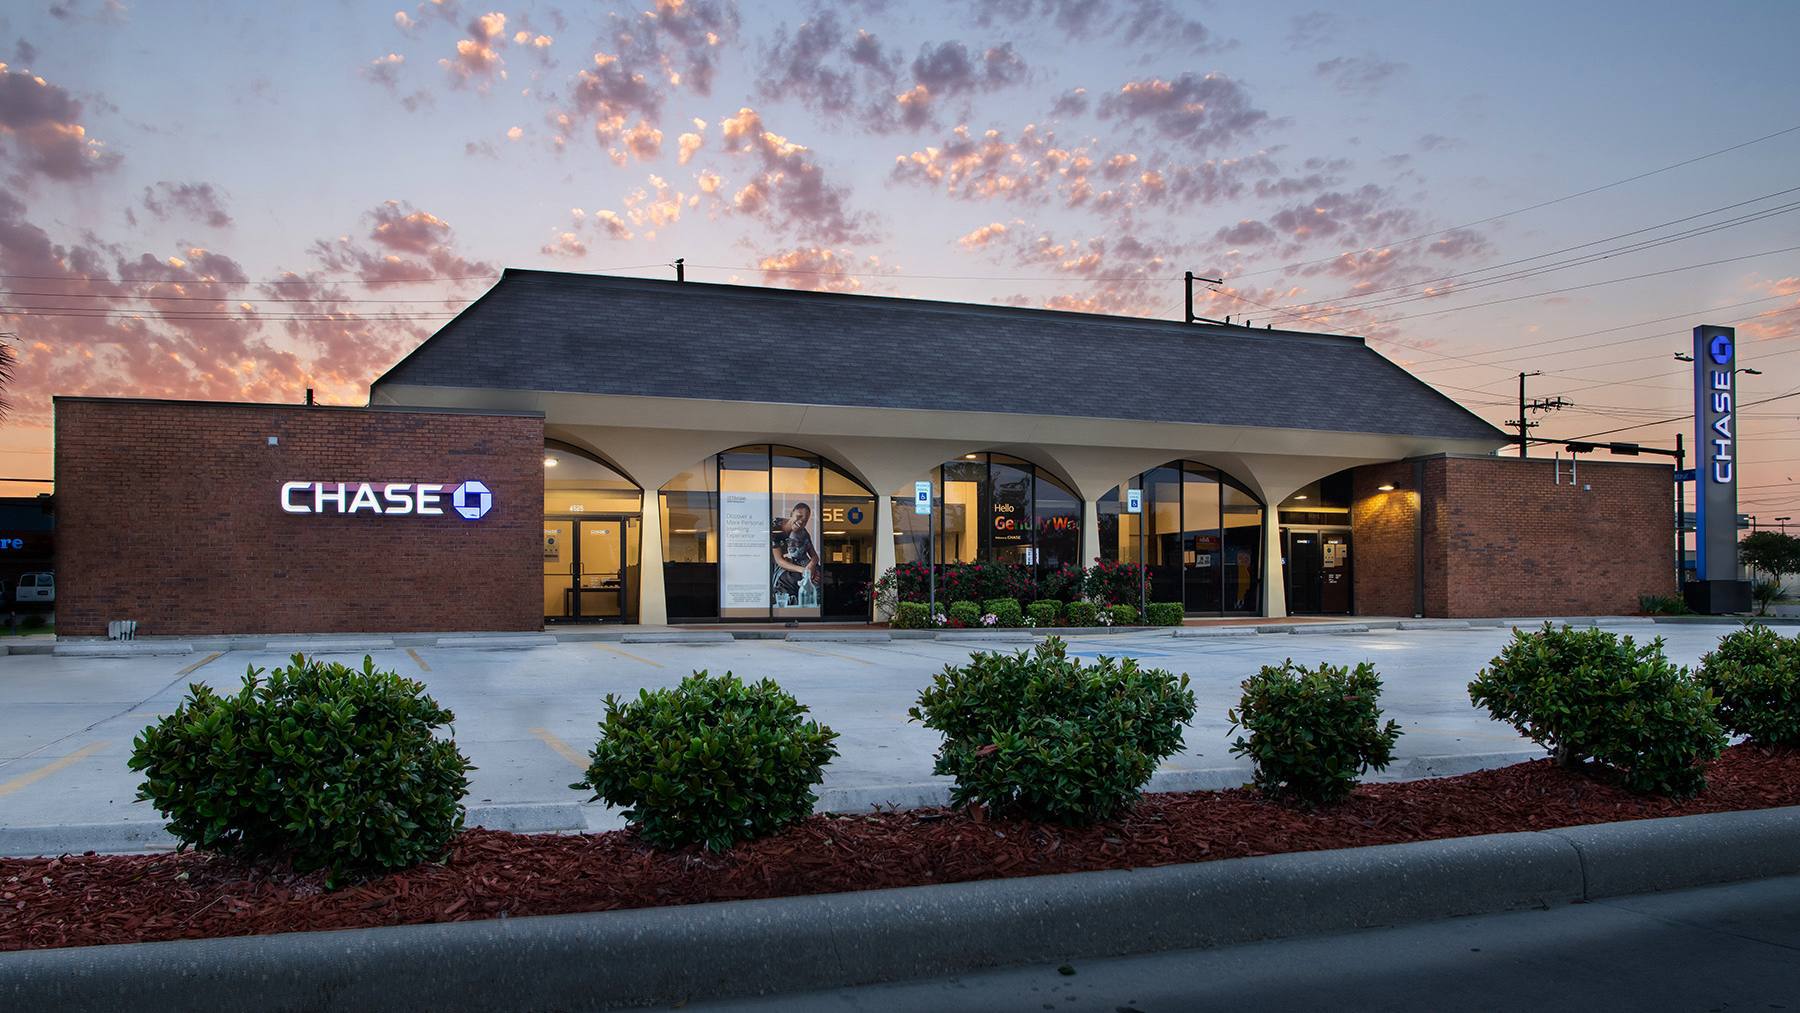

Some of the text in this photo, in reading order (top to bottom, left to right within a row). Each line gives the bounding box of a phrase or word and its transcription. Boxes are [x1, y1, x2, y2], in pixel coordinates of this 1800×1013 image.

[1713, 370, 1732, 483] CHASE
[281, 481, 444, 514] CHASE
[994, 503, 1015, 513] Hello
